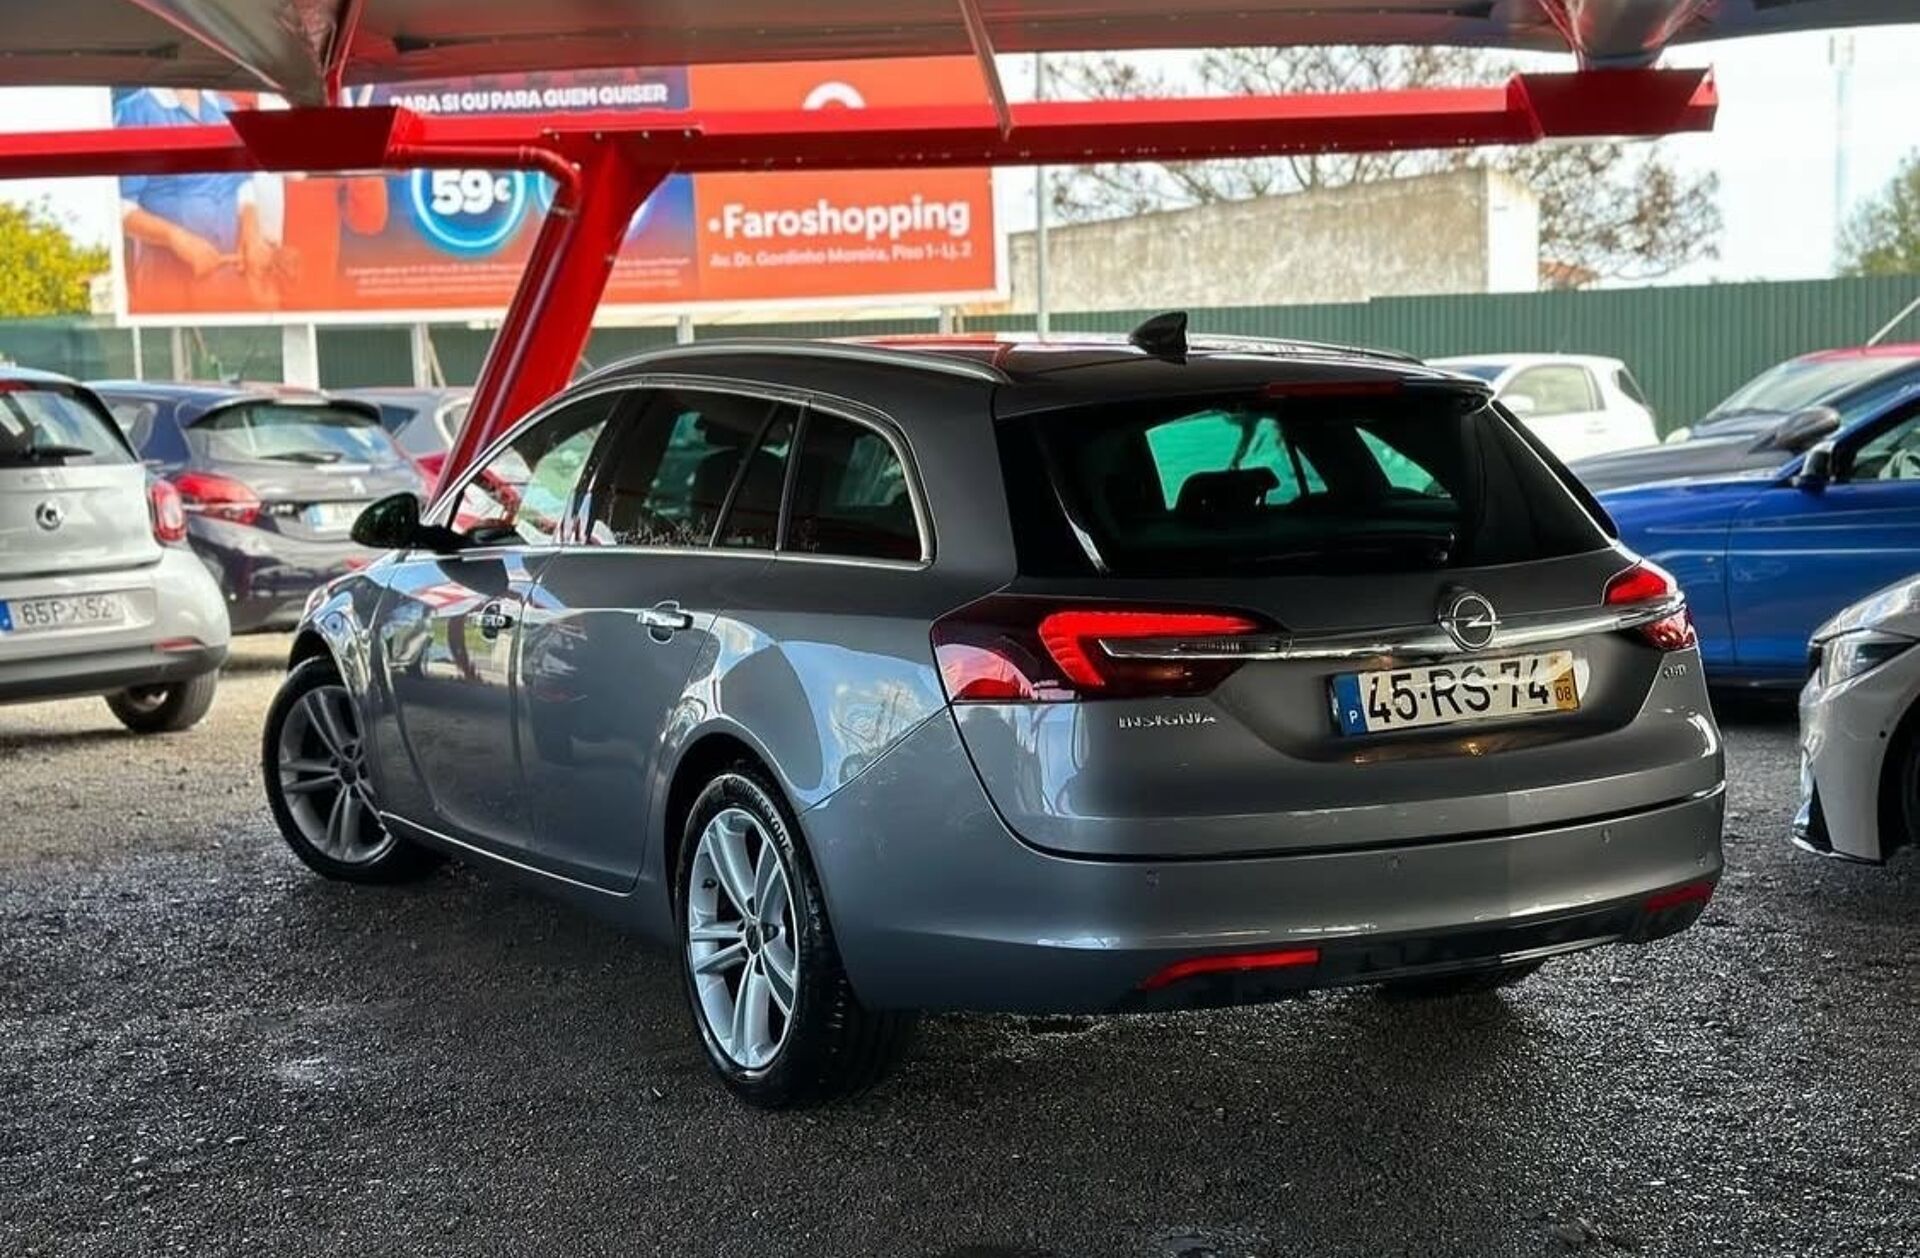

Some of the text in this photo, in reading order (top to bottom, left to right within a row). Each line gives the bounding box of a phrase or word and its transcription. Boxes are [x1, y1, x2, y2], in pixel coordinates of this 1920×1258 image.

[441, 93, 460, 113] SI
[461, 91, 488, 111] OU
[491, 89, 543, 109] PARA
[723, 194, 970, 240] Faroshopping
[1556, 686, 1572, 701] 08
[1349, 710, 1358, 724] P
